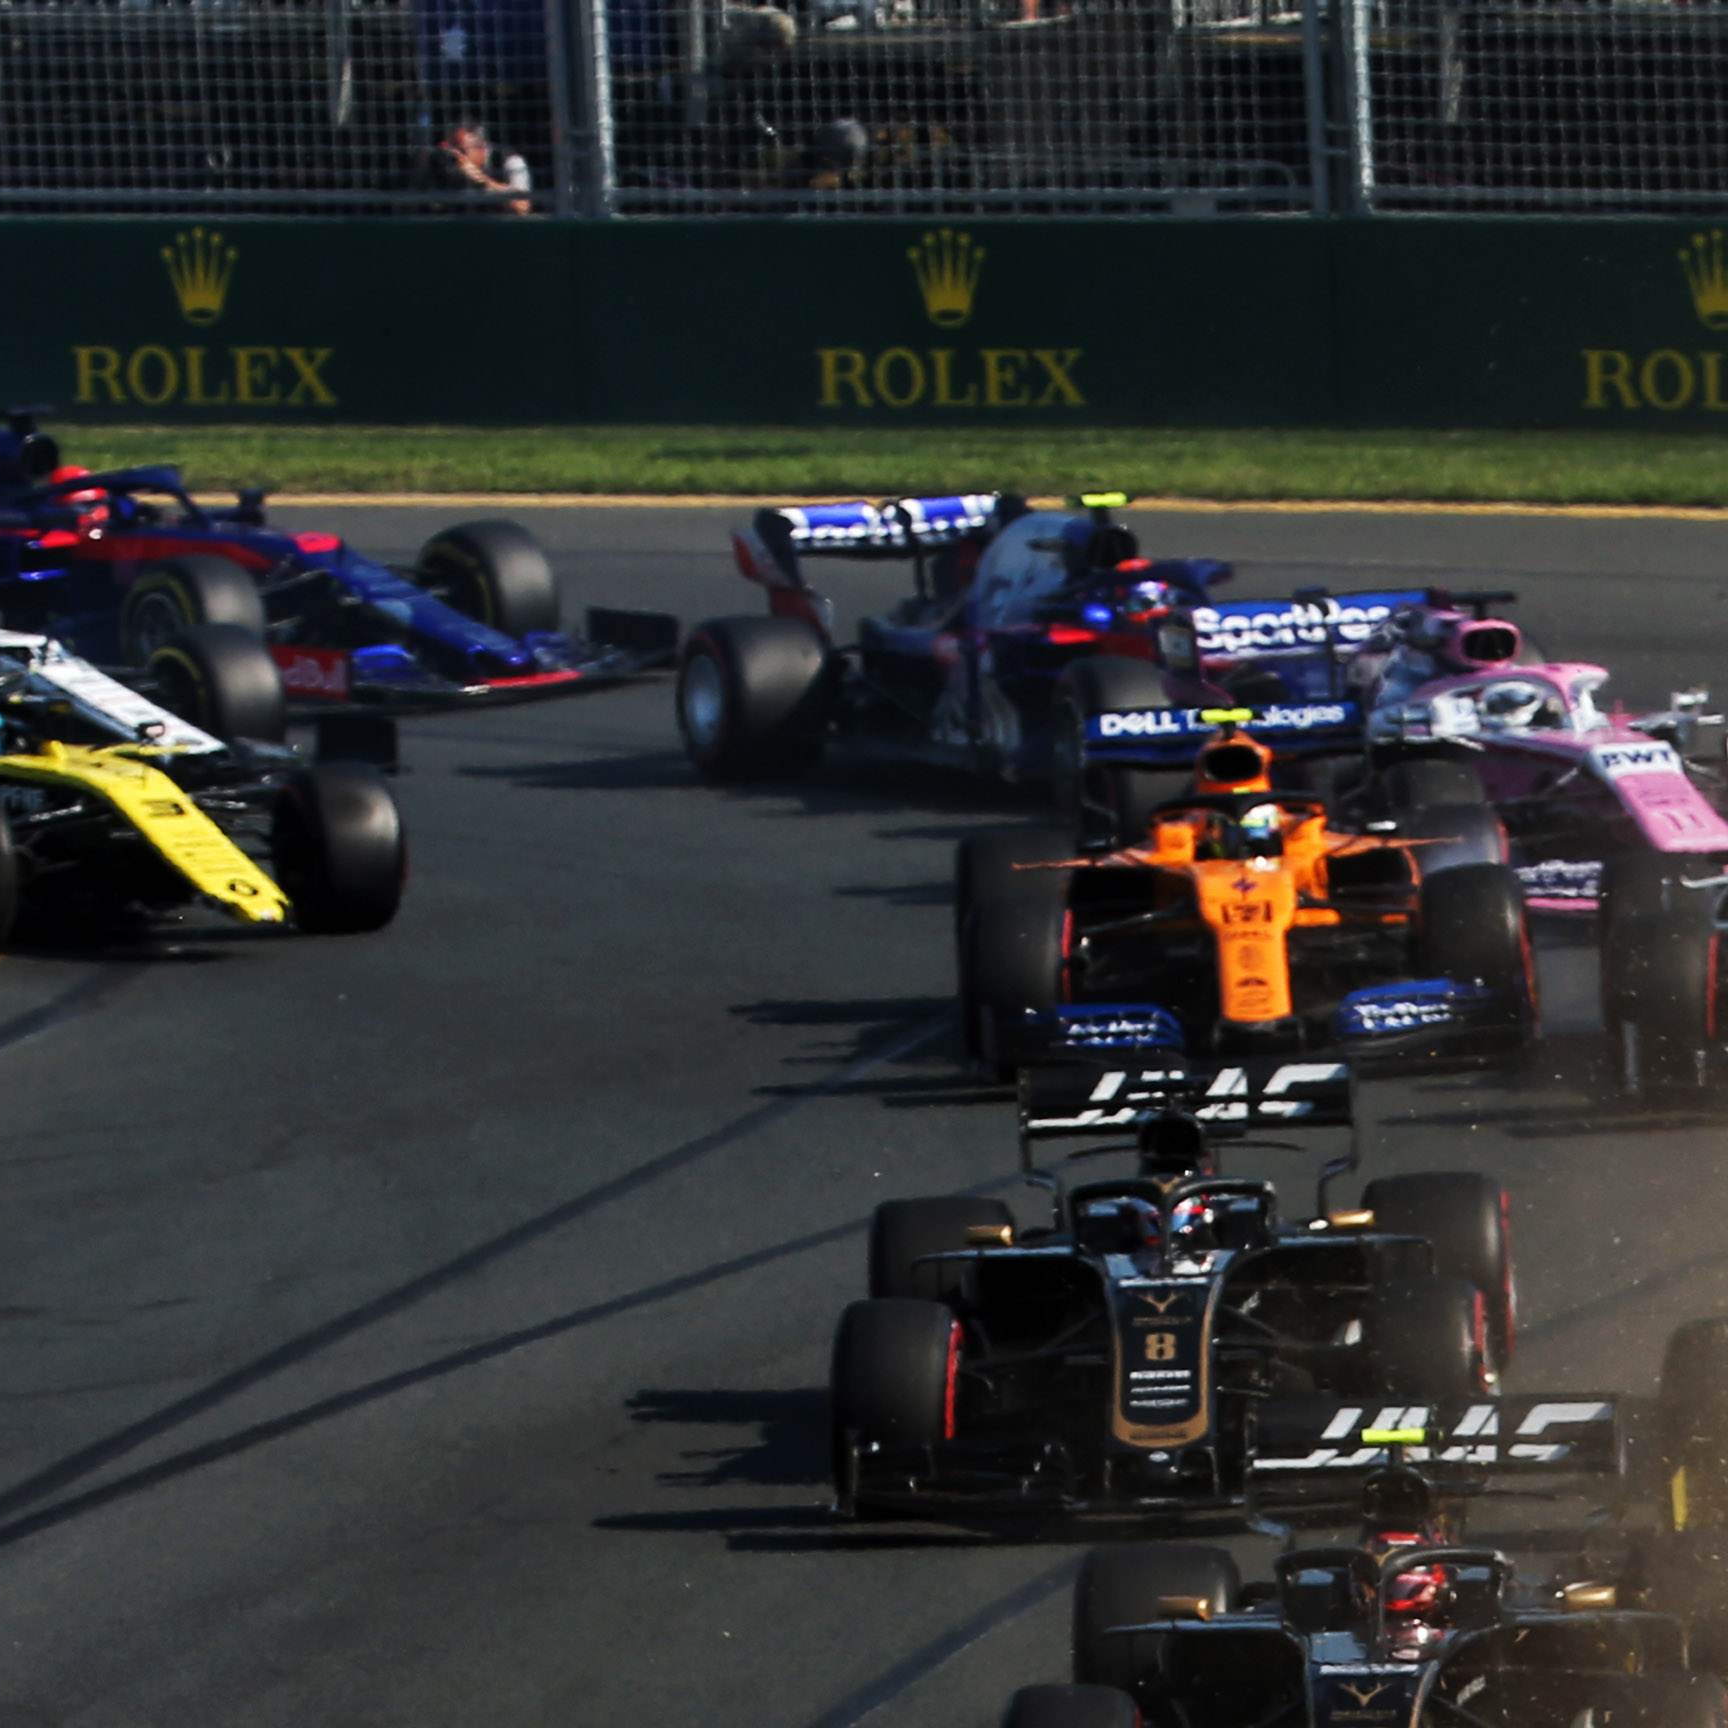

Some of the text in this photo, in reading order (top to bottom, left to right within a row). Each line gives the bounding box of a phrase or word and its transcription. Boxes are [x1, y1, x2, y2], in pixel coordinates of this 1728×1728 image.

[74, 346, 334, 403] ROLEX
[817, 348, 1084, 405] ROLEX
[1101, 712, 1180, 735] DELL
[1602, 751, 1671, 767] BWT
[1145, 1333, 1177, 1360] 8
